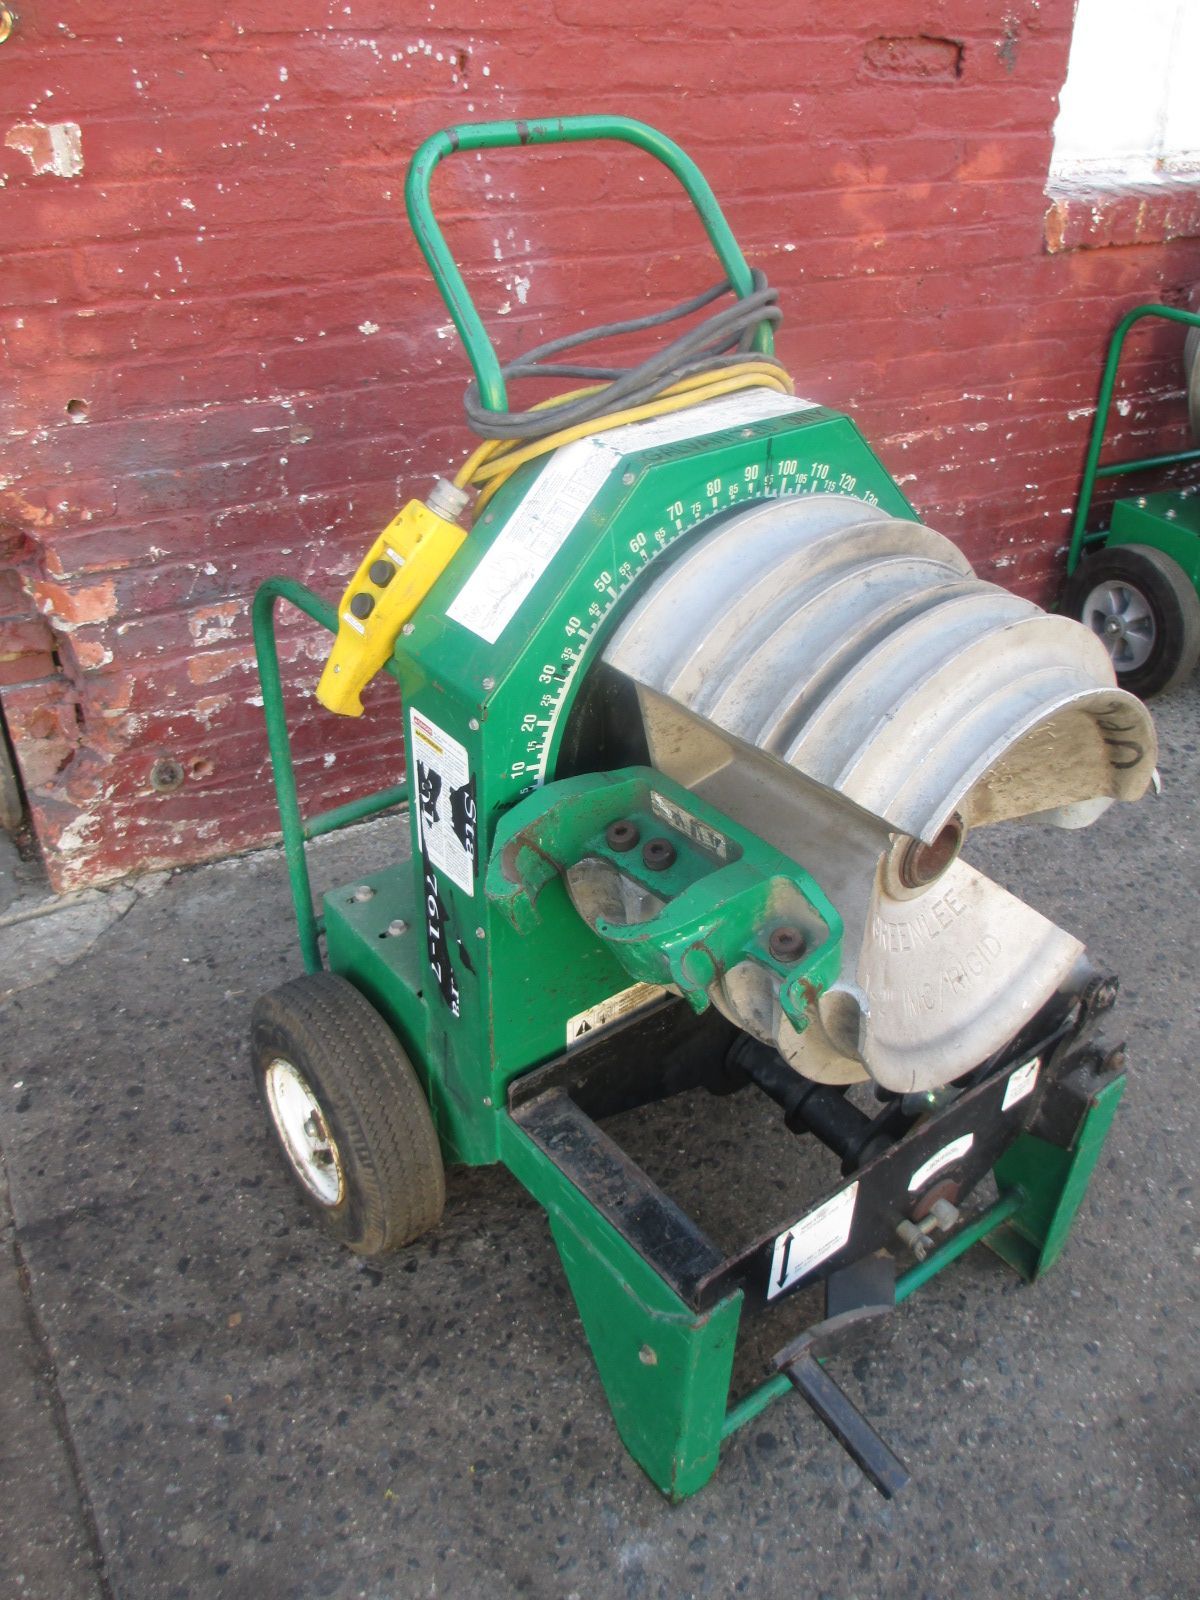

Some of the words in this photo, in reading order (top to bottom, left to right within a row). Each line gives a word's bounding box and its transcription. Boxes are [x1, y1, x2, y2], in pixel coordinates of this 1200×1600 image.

[744, 464, 758, 481] 90
[778, 460, 797, 475] 100
[811, 462, 829, 479] 110
[796, 474, 808, 484] 105
[824, 480, 836, 492] 115
[839, 473, 856, 491] 120
[706, 478, 721, 497] 80
[728, 483, 739, 495] 85
[667, 501, 683, 520] 70
[690, 502, 702, 514] 75
[654, 527, 666, 541] 65
[629, 532, 646, 553] 60
[619, 562, 630, 576] 55
[594, 571, 611, 592] 50
[588, 602, 600, 616] 45
[565, 616, 581, 636] 40
[561, 647, 573, 660] 35
[539, 664, 556, 684] 30
[540, 694, 552, 707] 25
[520, 714, 537, 732] 20
[526, 741, 537, 752] 15
[511, 761, 526, 780] 10
[520, 787, 529, 795] 5
[427, 873, 443, 984] 761-7
